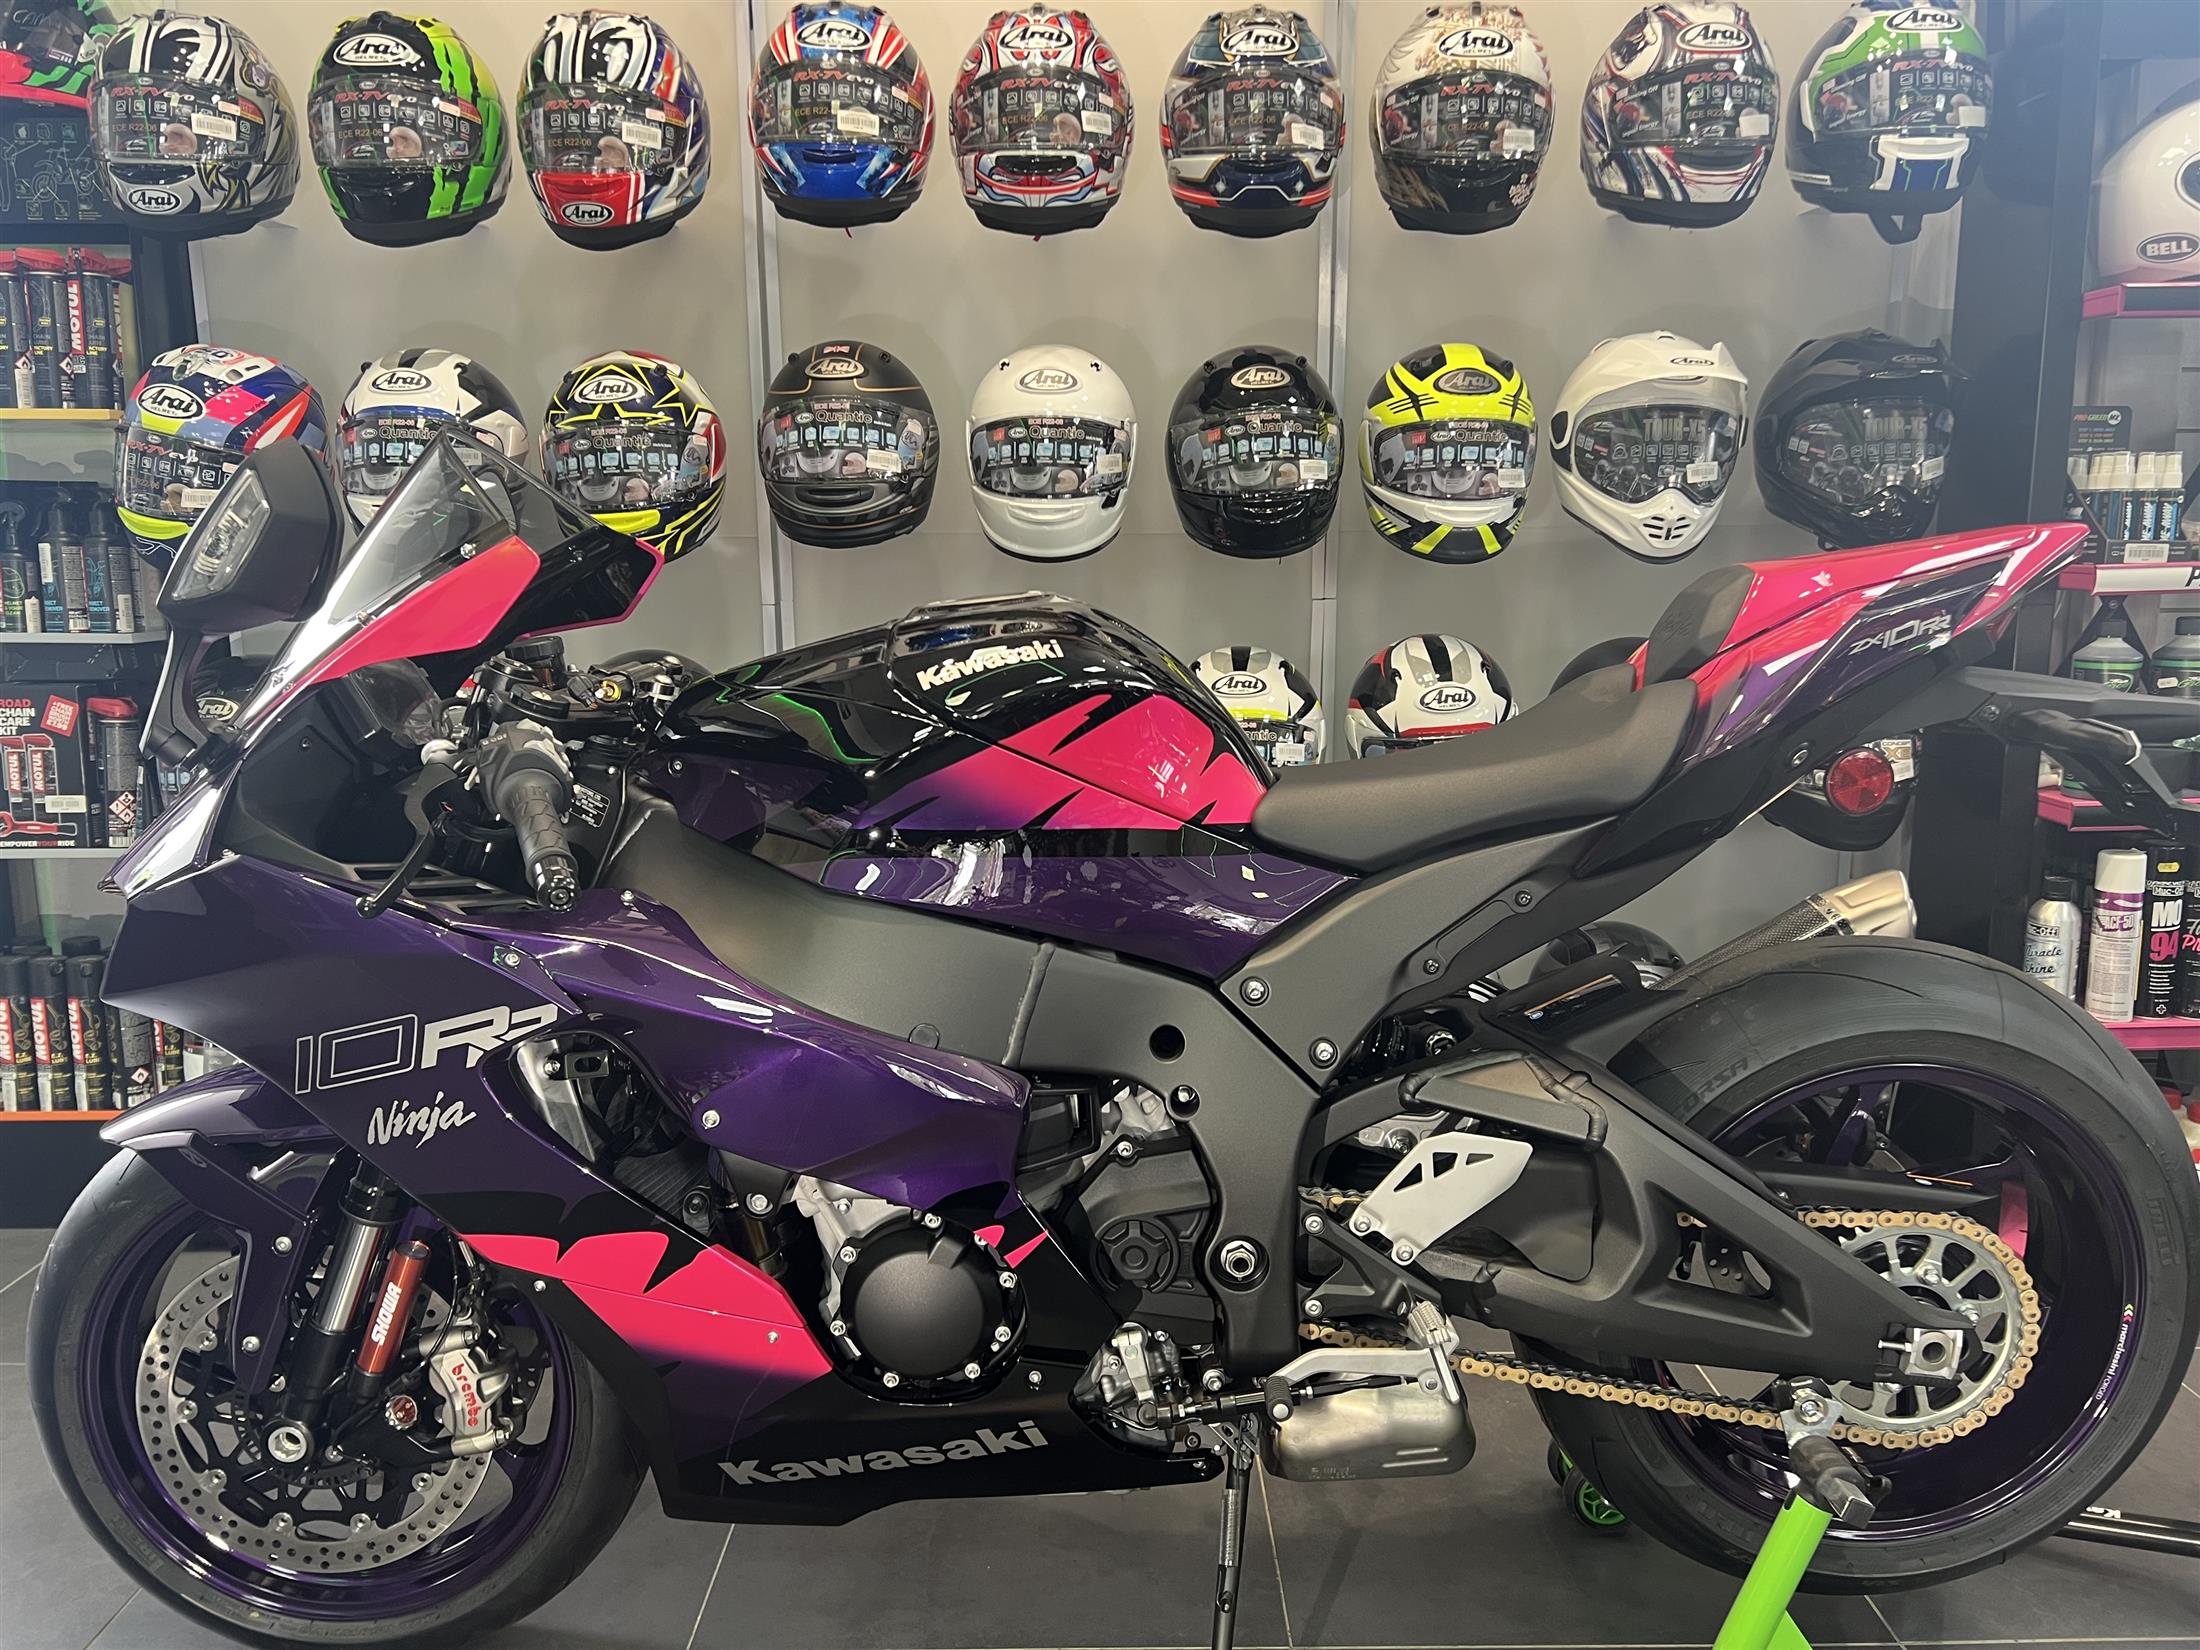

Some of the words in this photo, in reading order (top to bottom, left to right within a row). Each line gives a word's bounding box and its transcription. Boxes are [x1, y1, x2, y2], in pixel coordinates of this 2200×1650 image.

[1895, 11, 1953, 27] Arai
[805, 23, 861, 40] Arai
[1009, 27, 1064, 43] Arai
[1230, 30, 1288, 47] Arai
[1688, 25, 1743, 42] Arai
[1446, 32, 1506, 48] Arai
[793, 69, 849, 82] RX-7V
[1000, 77, 1056, 90] RX-7V
[1683, 71, 1741, 85] RX-7V
[111, 86, 166, 98] RX-7V
[1227, 79, 1283, 92] RX-7V
[1440, 84, 1497, 97] RX-7V
[335, 90, 391, 103] RX-7V
[544, 98, 599, 111] RX-7V
[795, 107, 812, 116] ECE
[133, 190, 175, 207] Arai
[564, 205, 609, 221] Arai
[2145, 239, 2194, 257] BELL
[67, 283, 83, 352] MOTUL
[812, 359, 856, 372] Arai
[376, 373, 424, 387] Arai
[1024, 370, 1071, 386] Arai
[1242, 368, 1284, 382] Arai
[1447, 373, 1493, 388] Arai
[582, 381, 630, 396] Arai
[143, 388, 195, 413] Arai
[815, 409, 874, 424] Quantic
[1028, 426, 1086, 441] Quantic
[1246, 419, 1304, 434] Quantic
[1642, 417, 1707, 441] TOUR-X5
[592, 434, 652, 450] Quantic
[1454, 430, 1510, 443] Quantic
[916, 638, 1065, 692] Kawasaki
[1216, 676, 1260, 690] Arai
[1428, 690, 1470, 705] Arai
[0, 707, 36, 717] CHAIN
[0, 717, 32, 727] CARE
[1244, 729, 1278, 742] antic
[8, 753, 21, 791] MOTUL
[31, 752, 45, 791] MOTUL
[2102, 913, 2135, 932] ACF-50
[2149, 930, 2180, 961] 94
[31, 1001, 48, 1061] MOTUL
[67, 1001, 82, 1061] MOTUL
[366, 1090, 478, 1149] Ninja
[370, 1281, 403, 1347] SHOWA
[2107, 1323, 2129, 1376] marchesini
[451, 1362, 483, 1428] brembo
[716, 1419, 1049, 1486] Kawasaki
